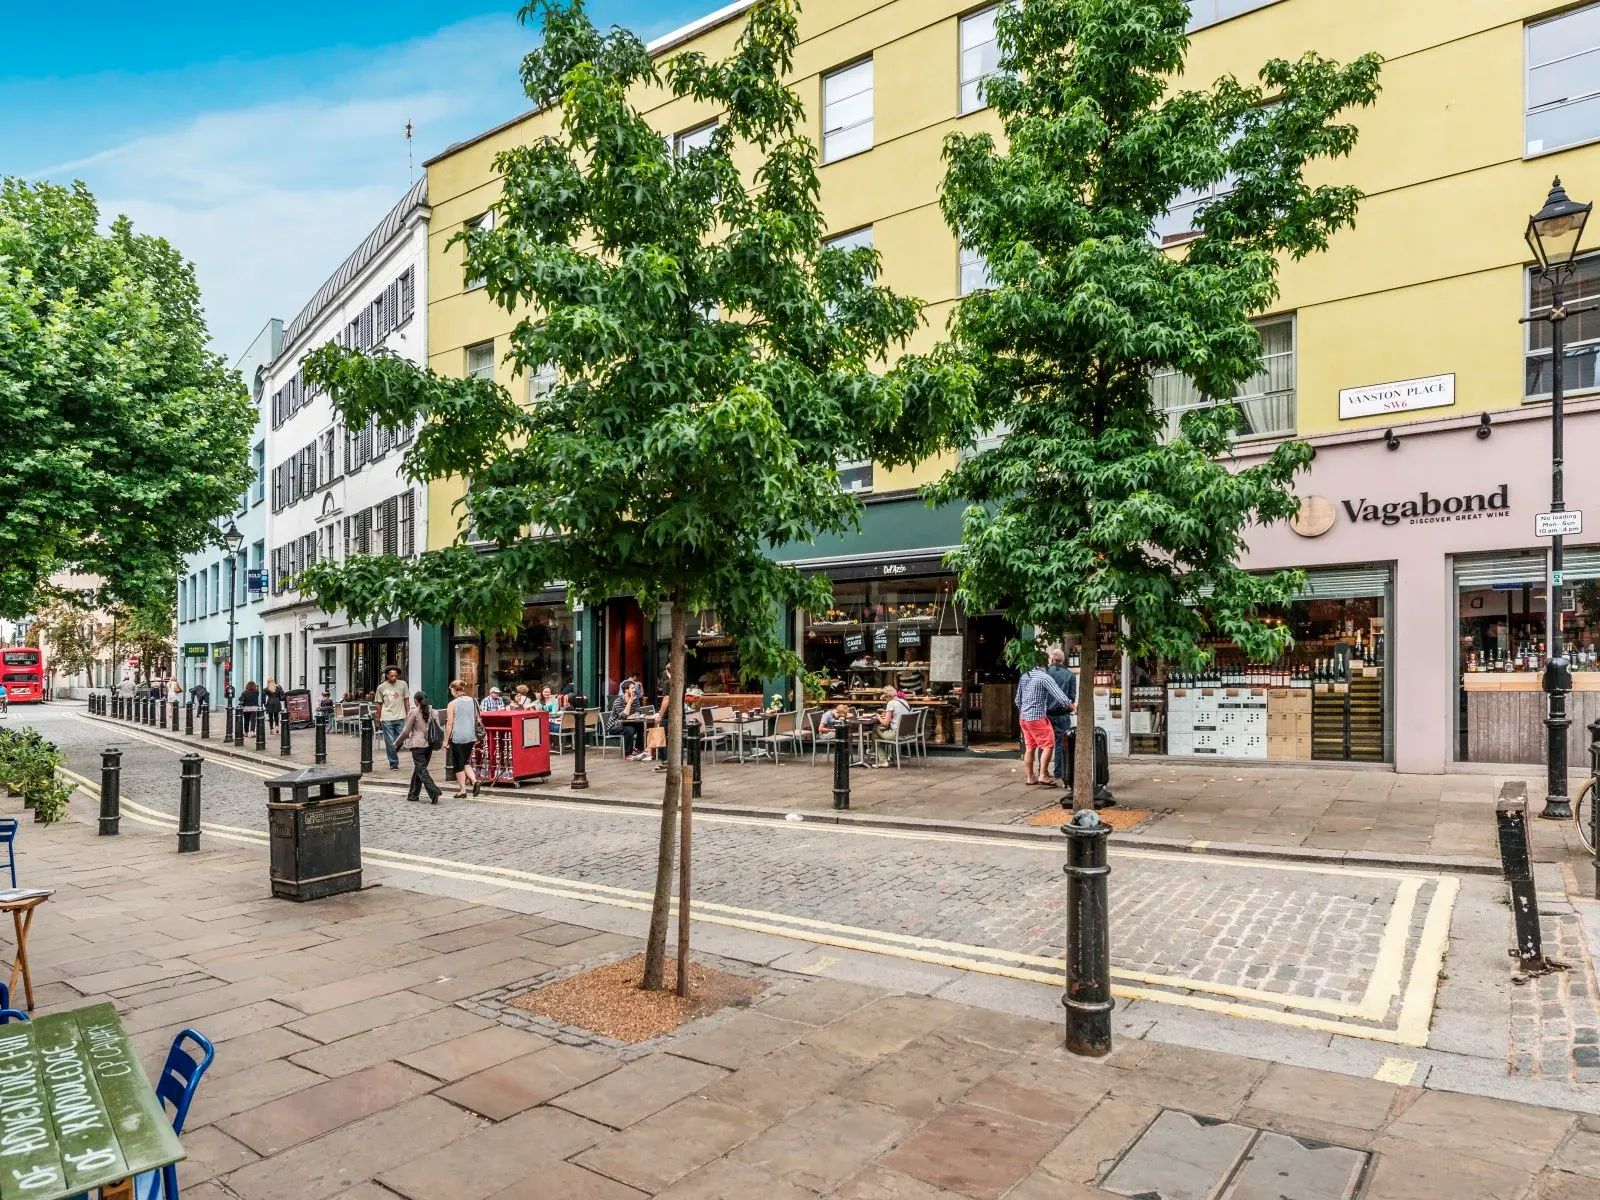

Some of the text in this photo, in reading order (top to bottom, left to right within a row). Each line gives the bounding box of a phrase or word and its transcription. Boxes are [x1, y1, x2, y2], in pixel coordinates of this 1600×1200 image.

[1348, 390, 1401, 404] VANSTON
[1407, 383, 1446, 397] PLACE
[1383, 400, 1408, 411] SW6
[1341, 483, 1511, 526] Vagabond
[1410, 510, 1510, 525] DISCOVER GREAT WINE
[41, 1040, 116, 1171] OF KNOWLEDGE
[12, 1165, 58, 1190] OF
